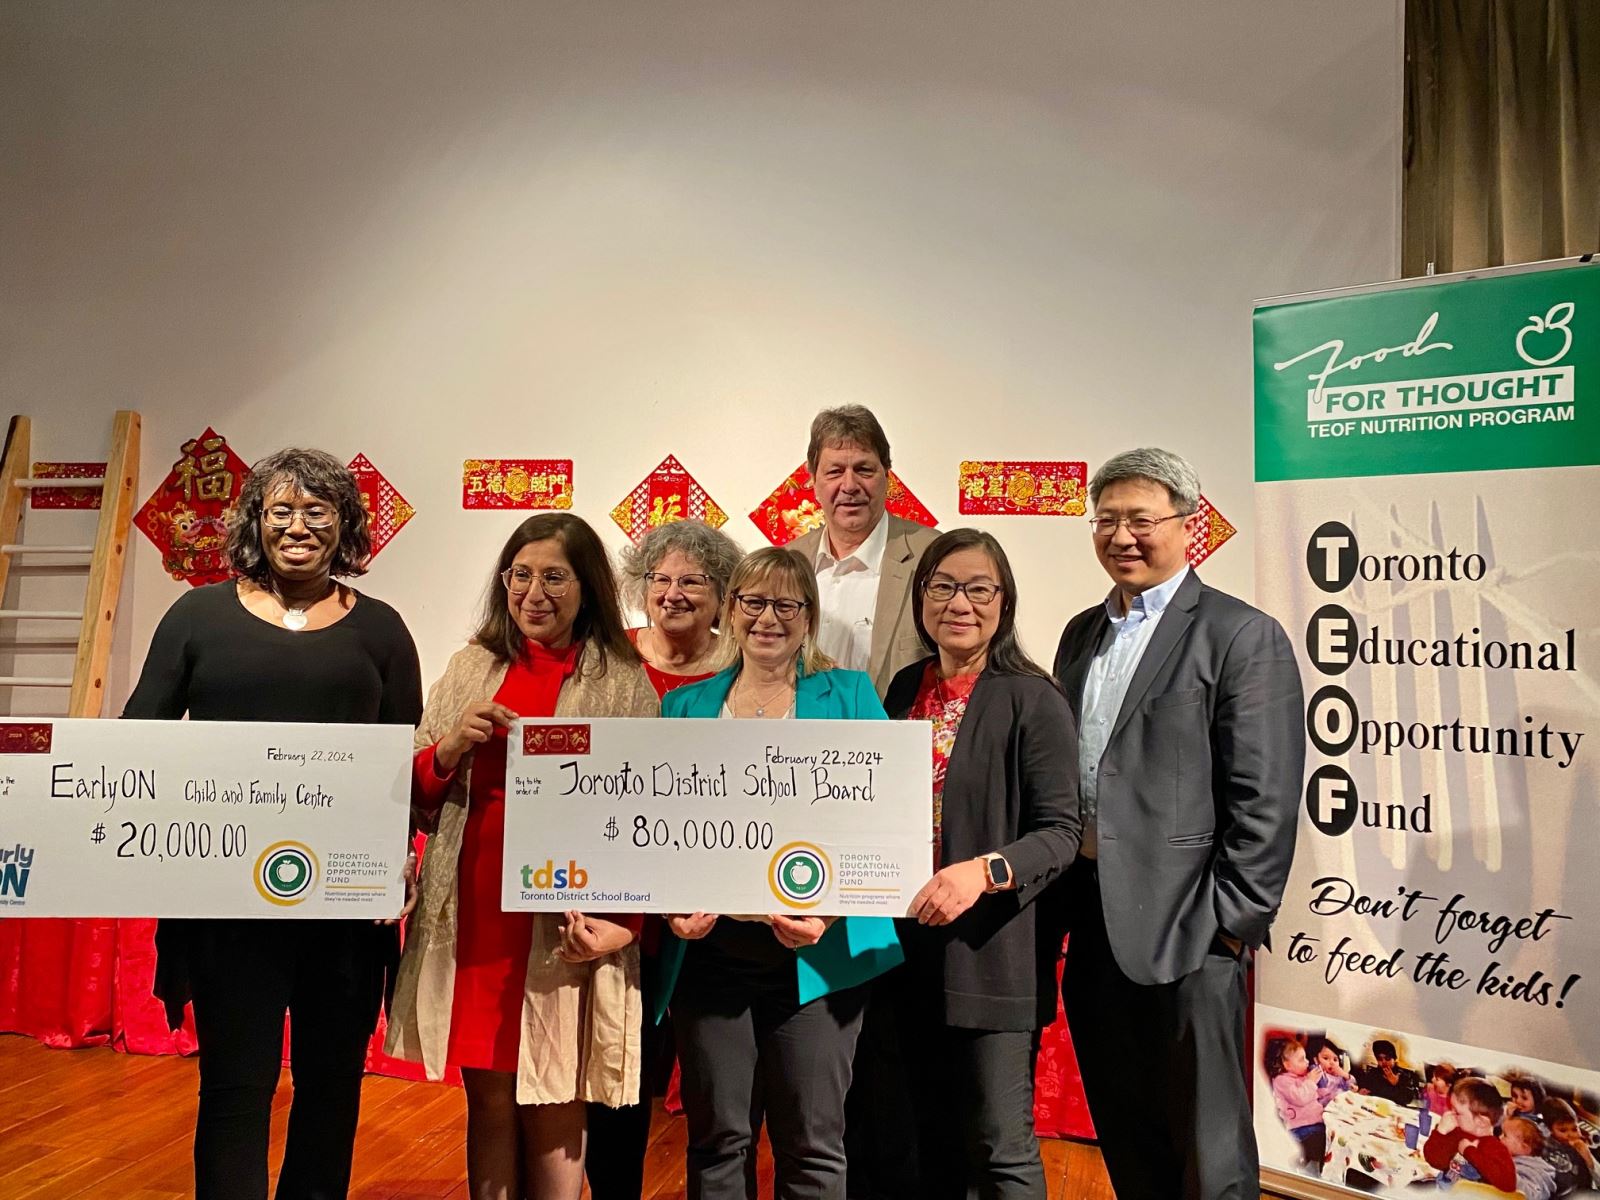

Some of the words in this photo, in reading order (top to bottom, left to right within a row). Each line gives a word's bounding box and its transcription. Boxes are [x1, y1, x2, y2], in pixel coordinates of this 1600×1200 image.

[1274, 312, 1453, 404] Food
[1326, 390, 1386, 414] FOR
[1396, 374, 1564, 408] THOUGHT
[1308, 424, 1356, 438] TEOF
[1361, 414, 1462, 435] NUTRITION
[1470, 406, 1574, 428] PROGRAM
[174, 437, 233, 500] 福
[1315, 532, 1486, 584] Toronto
[1316, 614, 1577, 672] Educational
[1313, 695, 1584, 768] Opportunity
[765, 746, 818, 770] February
[51, 763, 156, 813] EarlyON
[184, 779, 217, 803] Child
[222, 782, 244, 803] and
[248, 780, 287, 814] Family
[296, 783, 334, 810] Centre
[652, 762, 727, 798] District
[743, 764, 797, 806] School
[810, 768, 876, 806] Board
[1316, 775, 1432, 834] Fund
[90, 822, 106, 845] $
[116, 821, 246, 863] 20,000.00
[604, 816, 619, 842] $
[632, 815, 774, 850] 80,000.00
[520, 860, 588, 889] tdsb
[520, 892, 554, 900] Toronto
[556, 892, 589, 900] District
[592, 892, 622, 901] School
[624, 892, 650, 902] Board
[1309, 877, 1438, 920] Don't
[1435, 894, 1573, 952] forget
[1287, 932, 1320, 964] to
[1325, 937, 1404, 984] feed
[1413, 952, 1470, 990] the
[1476, 962, 1582, 1008] kids!
